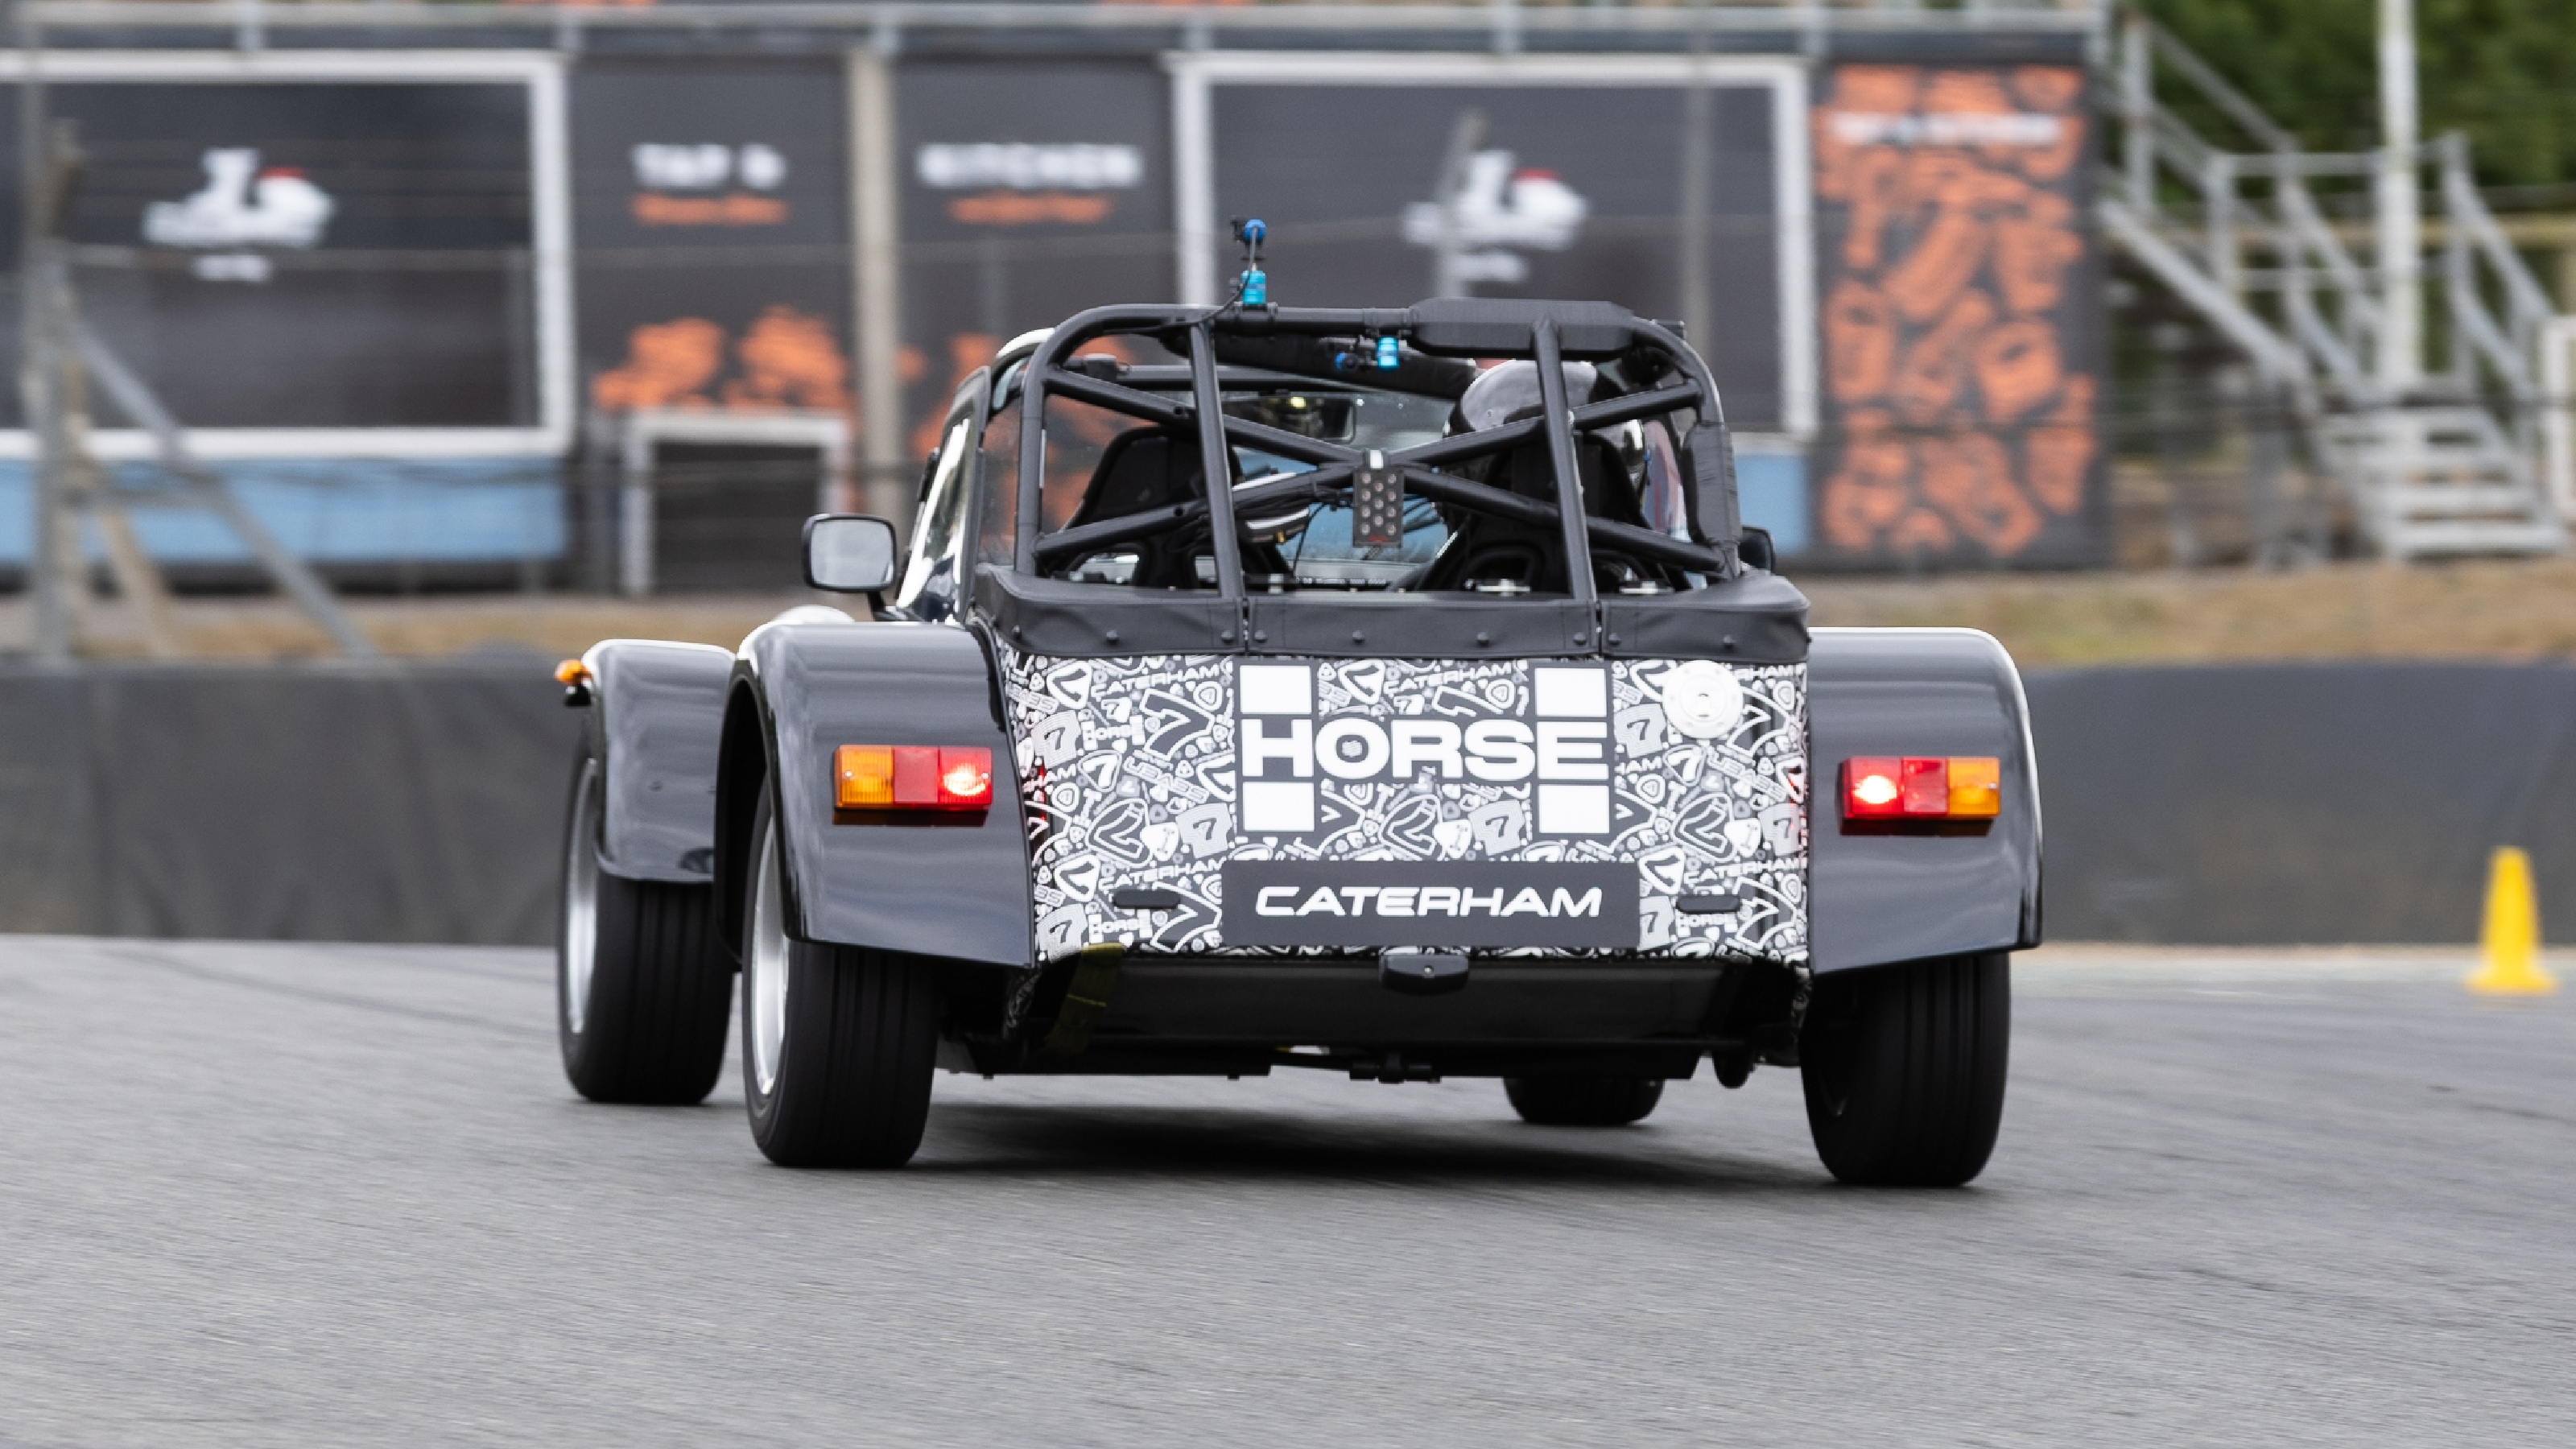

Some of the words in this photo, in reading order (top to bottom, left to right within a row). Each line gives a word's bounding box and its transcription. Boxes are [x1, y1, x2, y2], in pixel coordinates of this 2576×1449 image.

[1091, 664, 1220, 701] CATERHAM
[1384, 662, 1512, 698] CATERHAM
[1241, 717, 1608, 781] HORSE
[1256, 886, 1602, 918] CATERHAM
